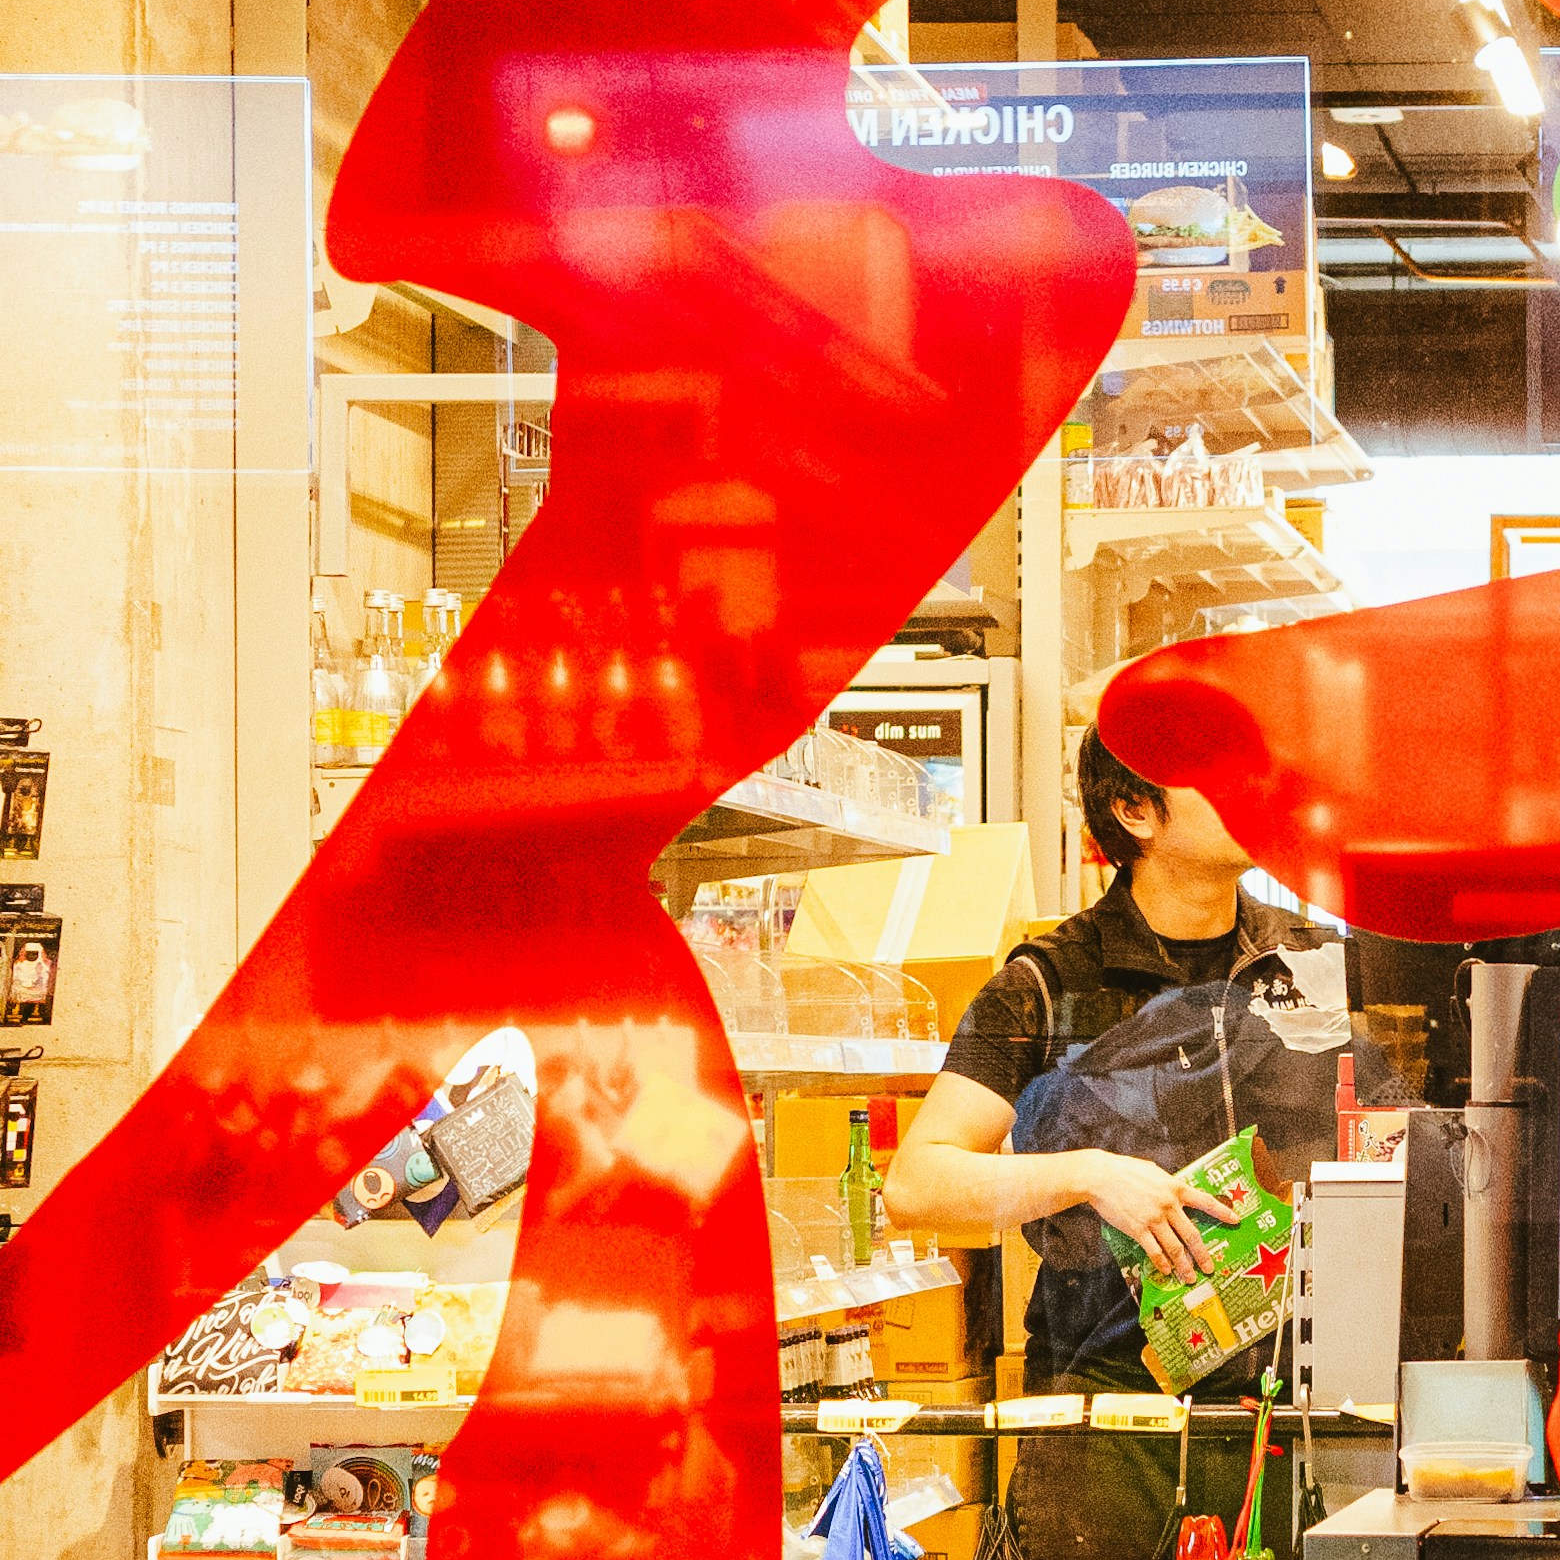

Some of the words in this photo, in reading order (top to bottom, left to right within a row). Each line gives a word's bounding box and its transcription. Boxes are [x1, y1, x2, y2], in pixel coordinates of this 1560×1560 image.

[874, 722, 904, 740] dim
[908, 725, 941, 740] sum
[187, 1327, 265, 1381] Kin
